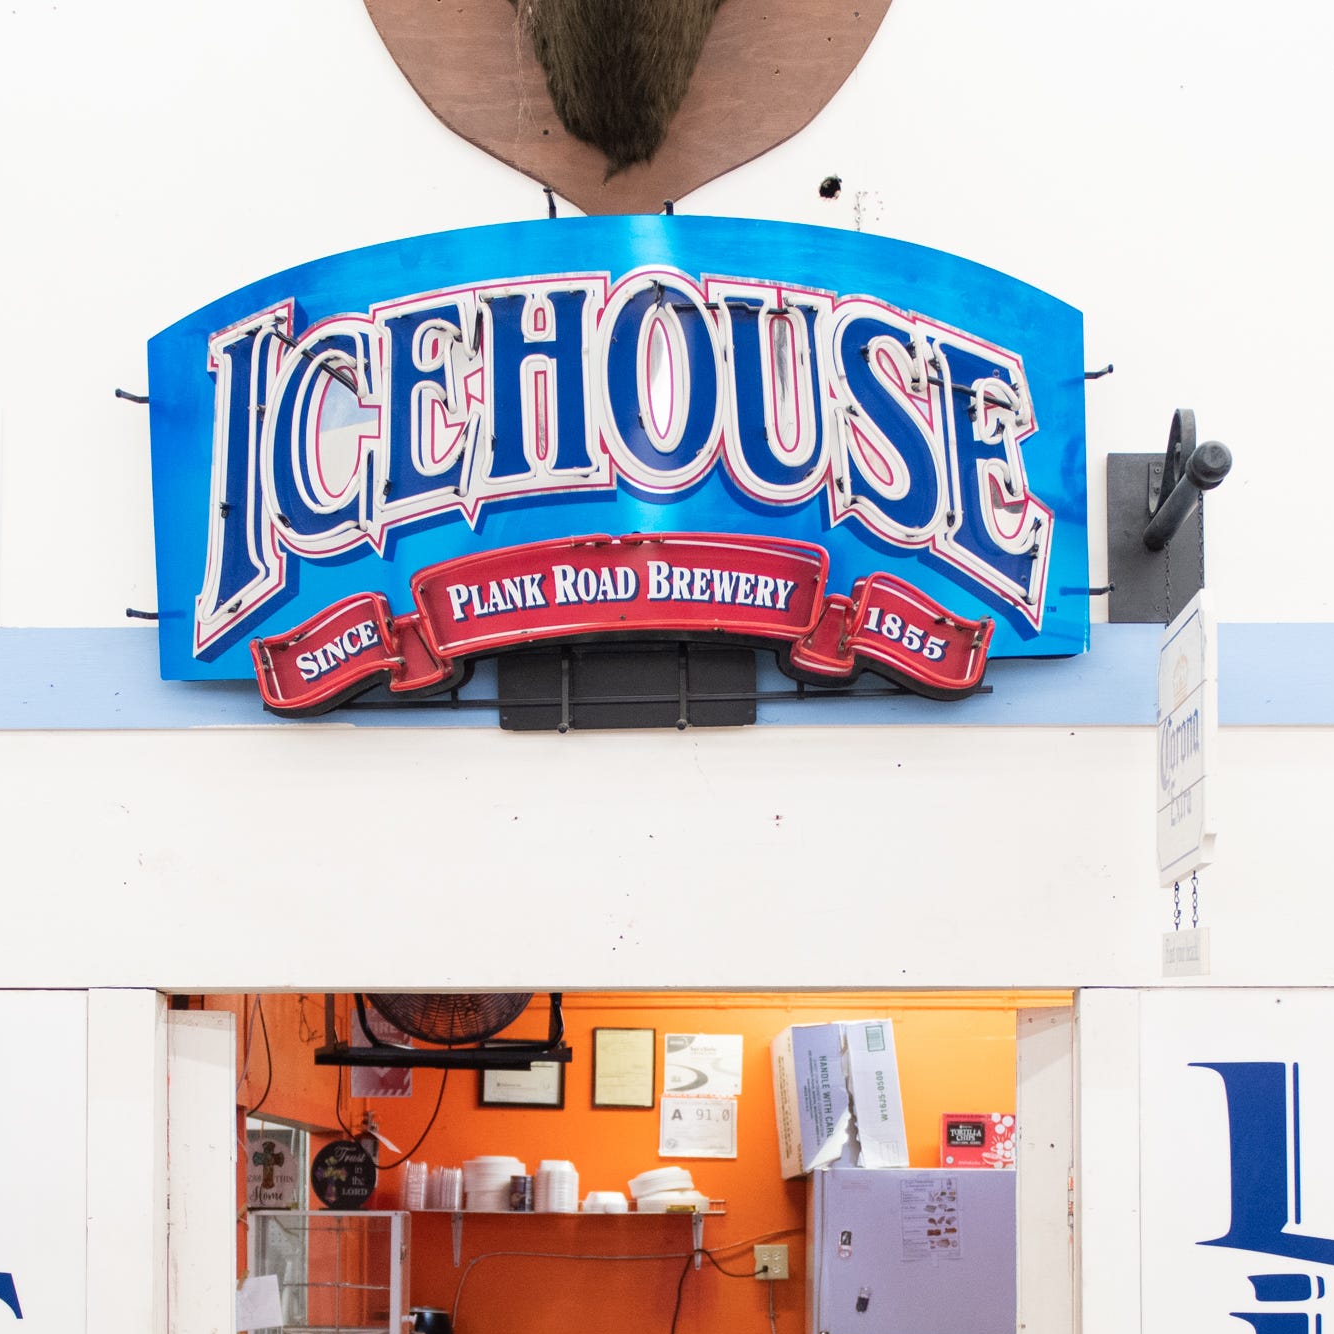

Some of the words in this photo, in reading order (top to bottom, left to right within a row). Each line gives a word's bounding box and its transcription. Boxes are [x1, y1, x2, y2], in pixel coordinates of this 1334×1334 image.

[193, 266, 1054, 657] ICEHOUSE
[447, 573, 549, 622] PLANK
[552, 564, 639, 604] ROAD
[647, 560, 796, 611] BREWERY
[295, 618, 380, 683] SINCE
[864, 607, 948, 663] 1855
[1159, 707, 1200, 792] Corona
[818, 1055, 831, 1090] HANDLE
[671, 1109, 683, 1120] A
[822, 1091, 833, 1116] WITH
[950, 1128, 982, 1137] TORTILLA
[333, 1145, 366, 1163] Trust
[342, 1188, 368, 1196] LORD
